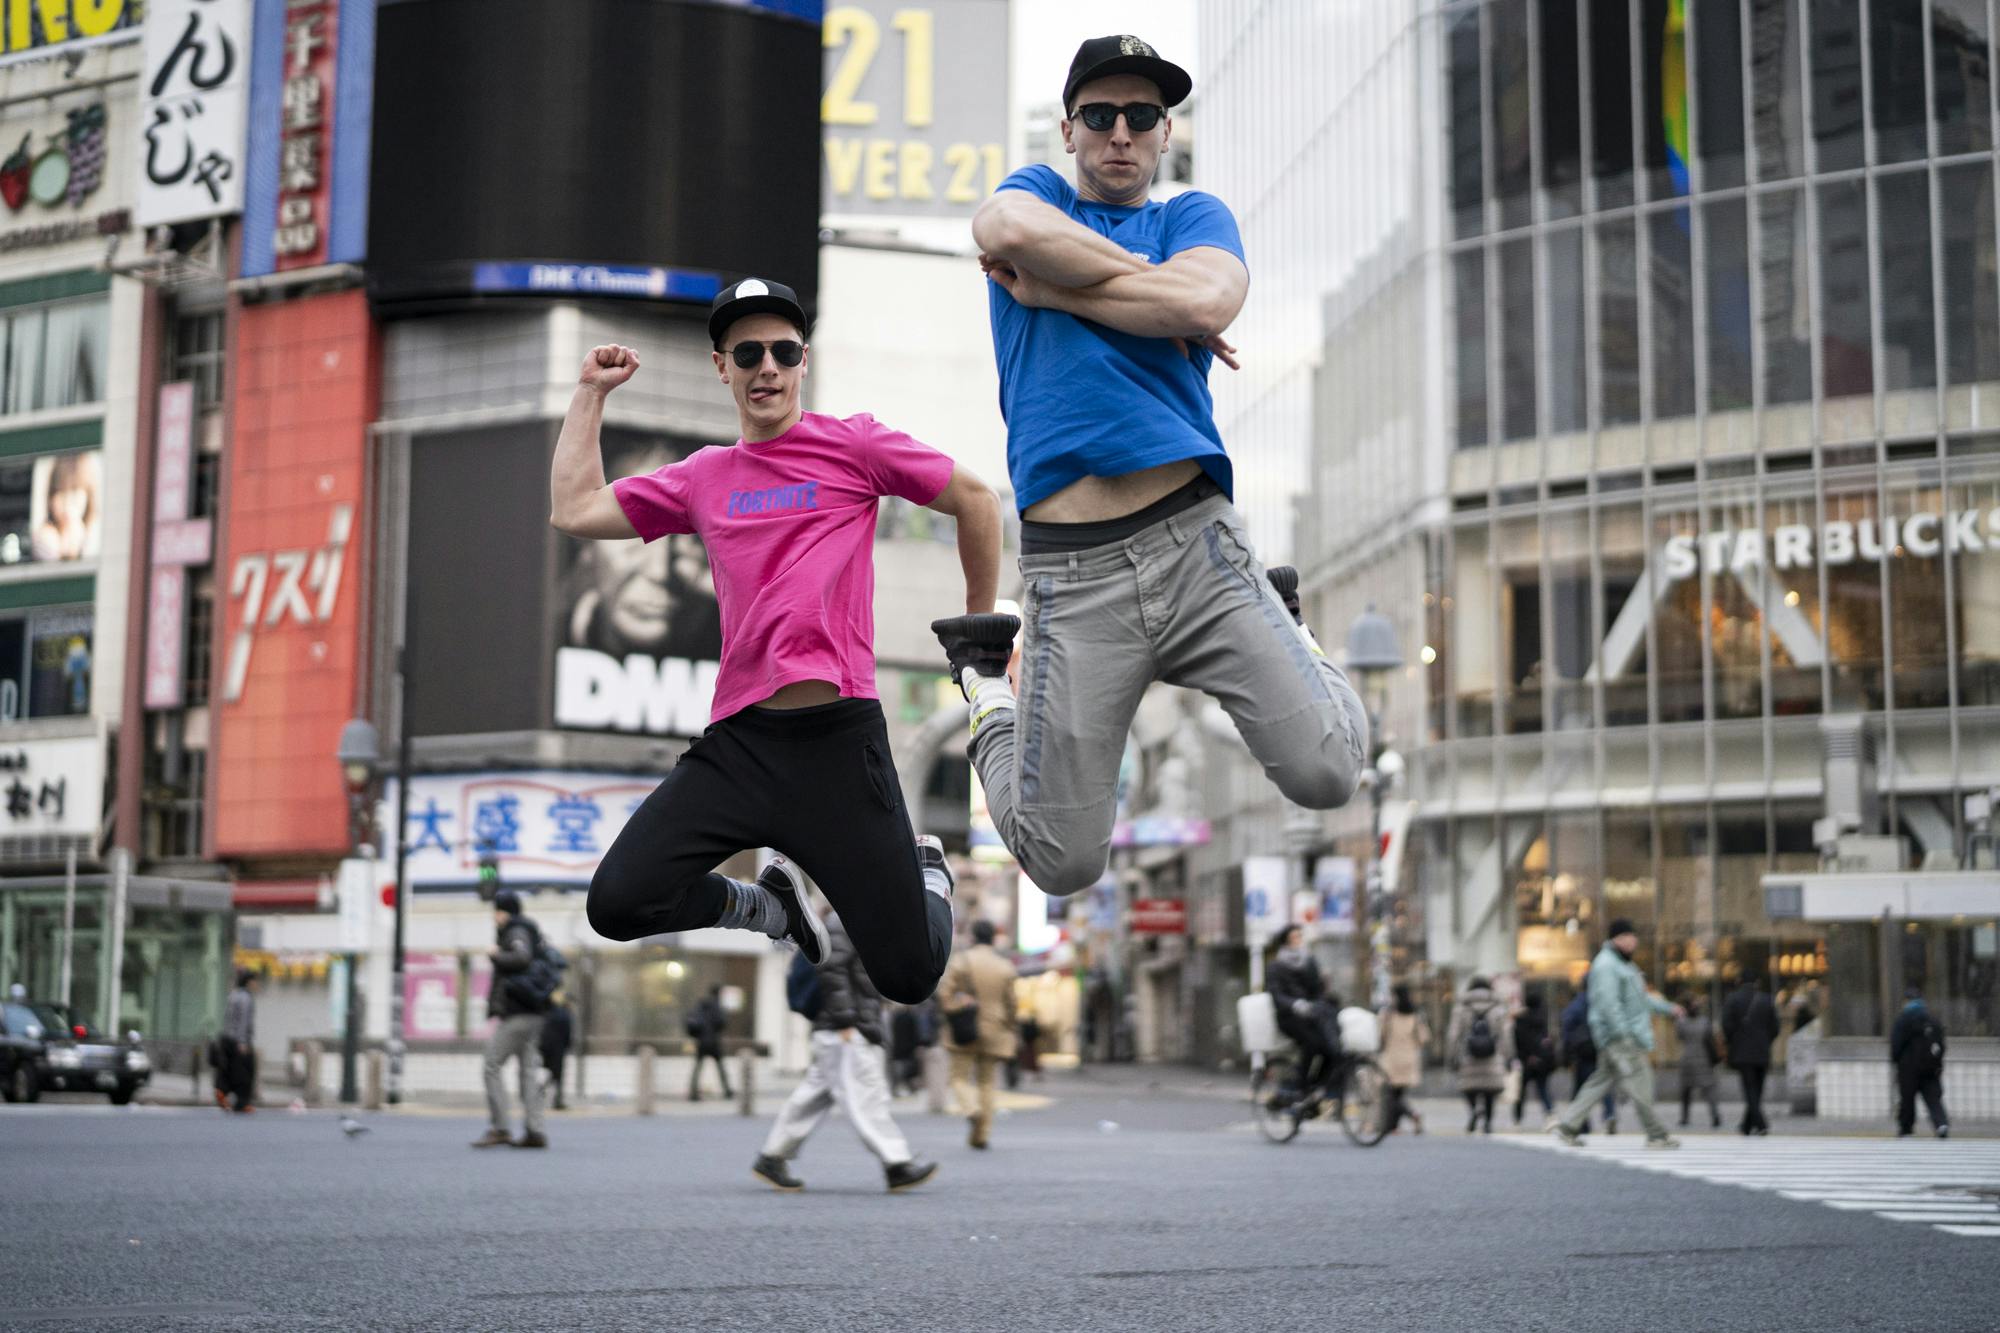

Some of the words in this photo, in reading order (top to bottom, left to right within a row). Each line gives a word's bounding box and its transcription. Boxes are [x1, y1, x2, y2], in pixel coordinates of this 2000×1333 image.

[145, 0, 236, 202] んじゃ
[821, 6, 934, 127] 21
[943, 142, 1004, 203] 21
[727, 481, 818, 518] FORTNITE
[223, 504, 354, 703] クスリ
[406, 793, 646, 855] 大盛堂
